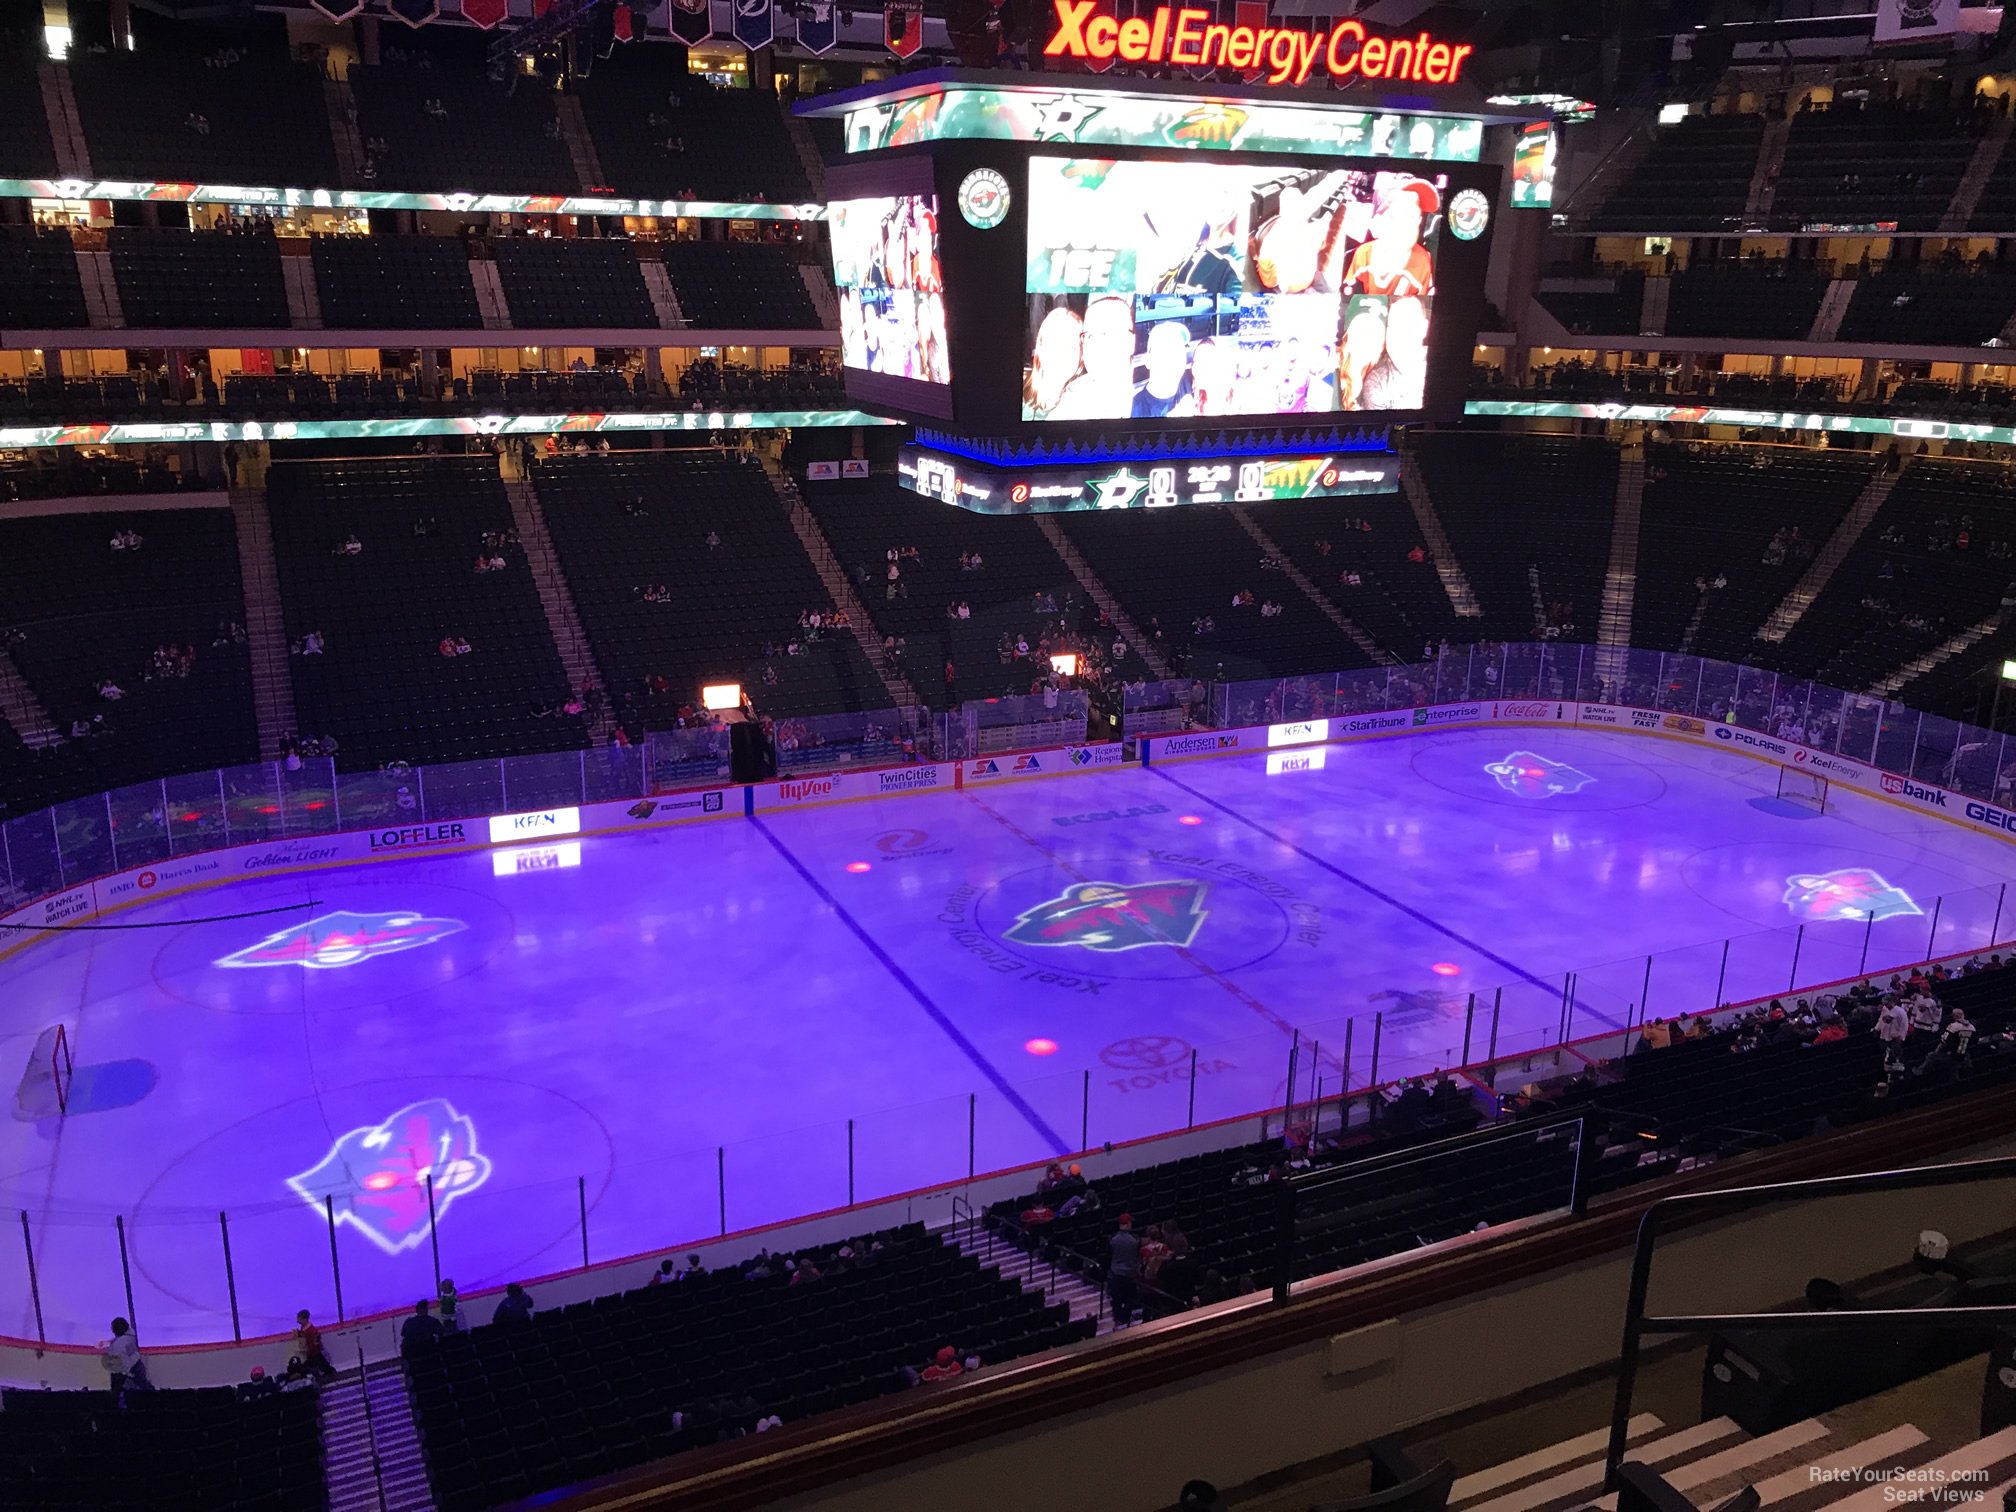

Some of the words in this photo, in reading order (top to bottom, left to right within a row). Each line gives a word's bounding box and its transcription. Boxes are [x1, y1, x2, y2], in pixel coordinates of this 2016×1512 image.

[1044, 0, 1171, 61] Xcel
[1170, 8, 1324, 84] Energy
[1326, 21, 1470, 83] Center
[1632, 711, 1661, 720] FRESH
[1349, 717, 1406, 732] StarTribune
[1633, 719, 1657, 728] FAST
[1165, 737, 1215, 752] Andersen
[1735, 732, 1786, 755] POLARIS
[1095, 755, 1121, 764] Hospita
[879, 768, 937, 784] TwinCities
[880, 781, 912, 791] PIONEER
[914, 778, 937, 788] PRESS
[1052, 804, 1171, 827] ECOLAB
[369, 823, 465, 848] LOFFLER
[244, 853, 291, 869] Golden
[296, 847, 339, 862] LIGHT
[71, 901, 89, 913] LIVE
[1106, 1059, 1239, 1093] TOYOTA
